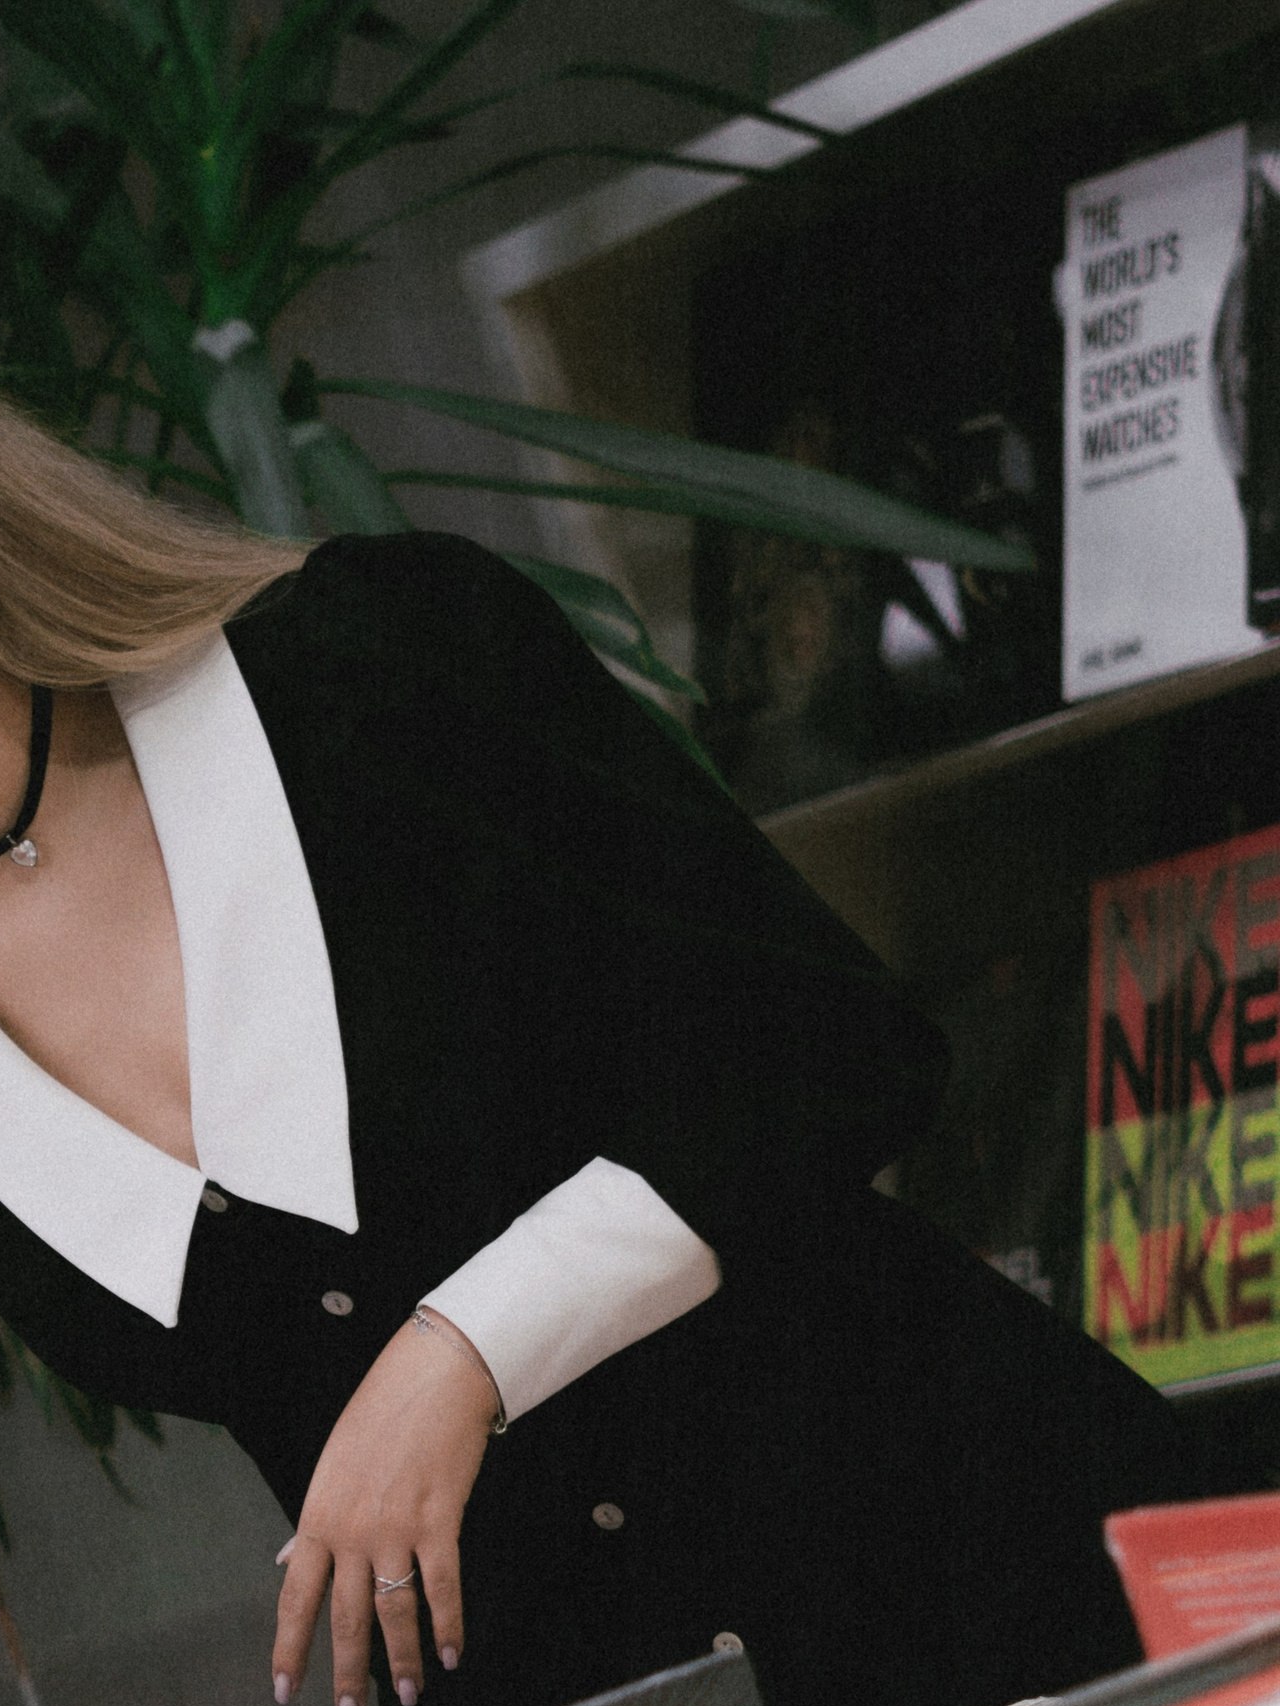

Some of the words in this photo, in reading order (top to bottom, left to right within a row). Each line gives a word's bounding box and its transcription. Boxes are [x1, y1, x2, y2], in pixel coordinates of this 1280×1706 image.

[1082, 300, 1142, 355] MOST
[1082, 335, 1200, 412] EXPENSIVE
[1082, 400, 1180, 463] WATCHES
[1100, 965, 1280, 1132] NIKE
